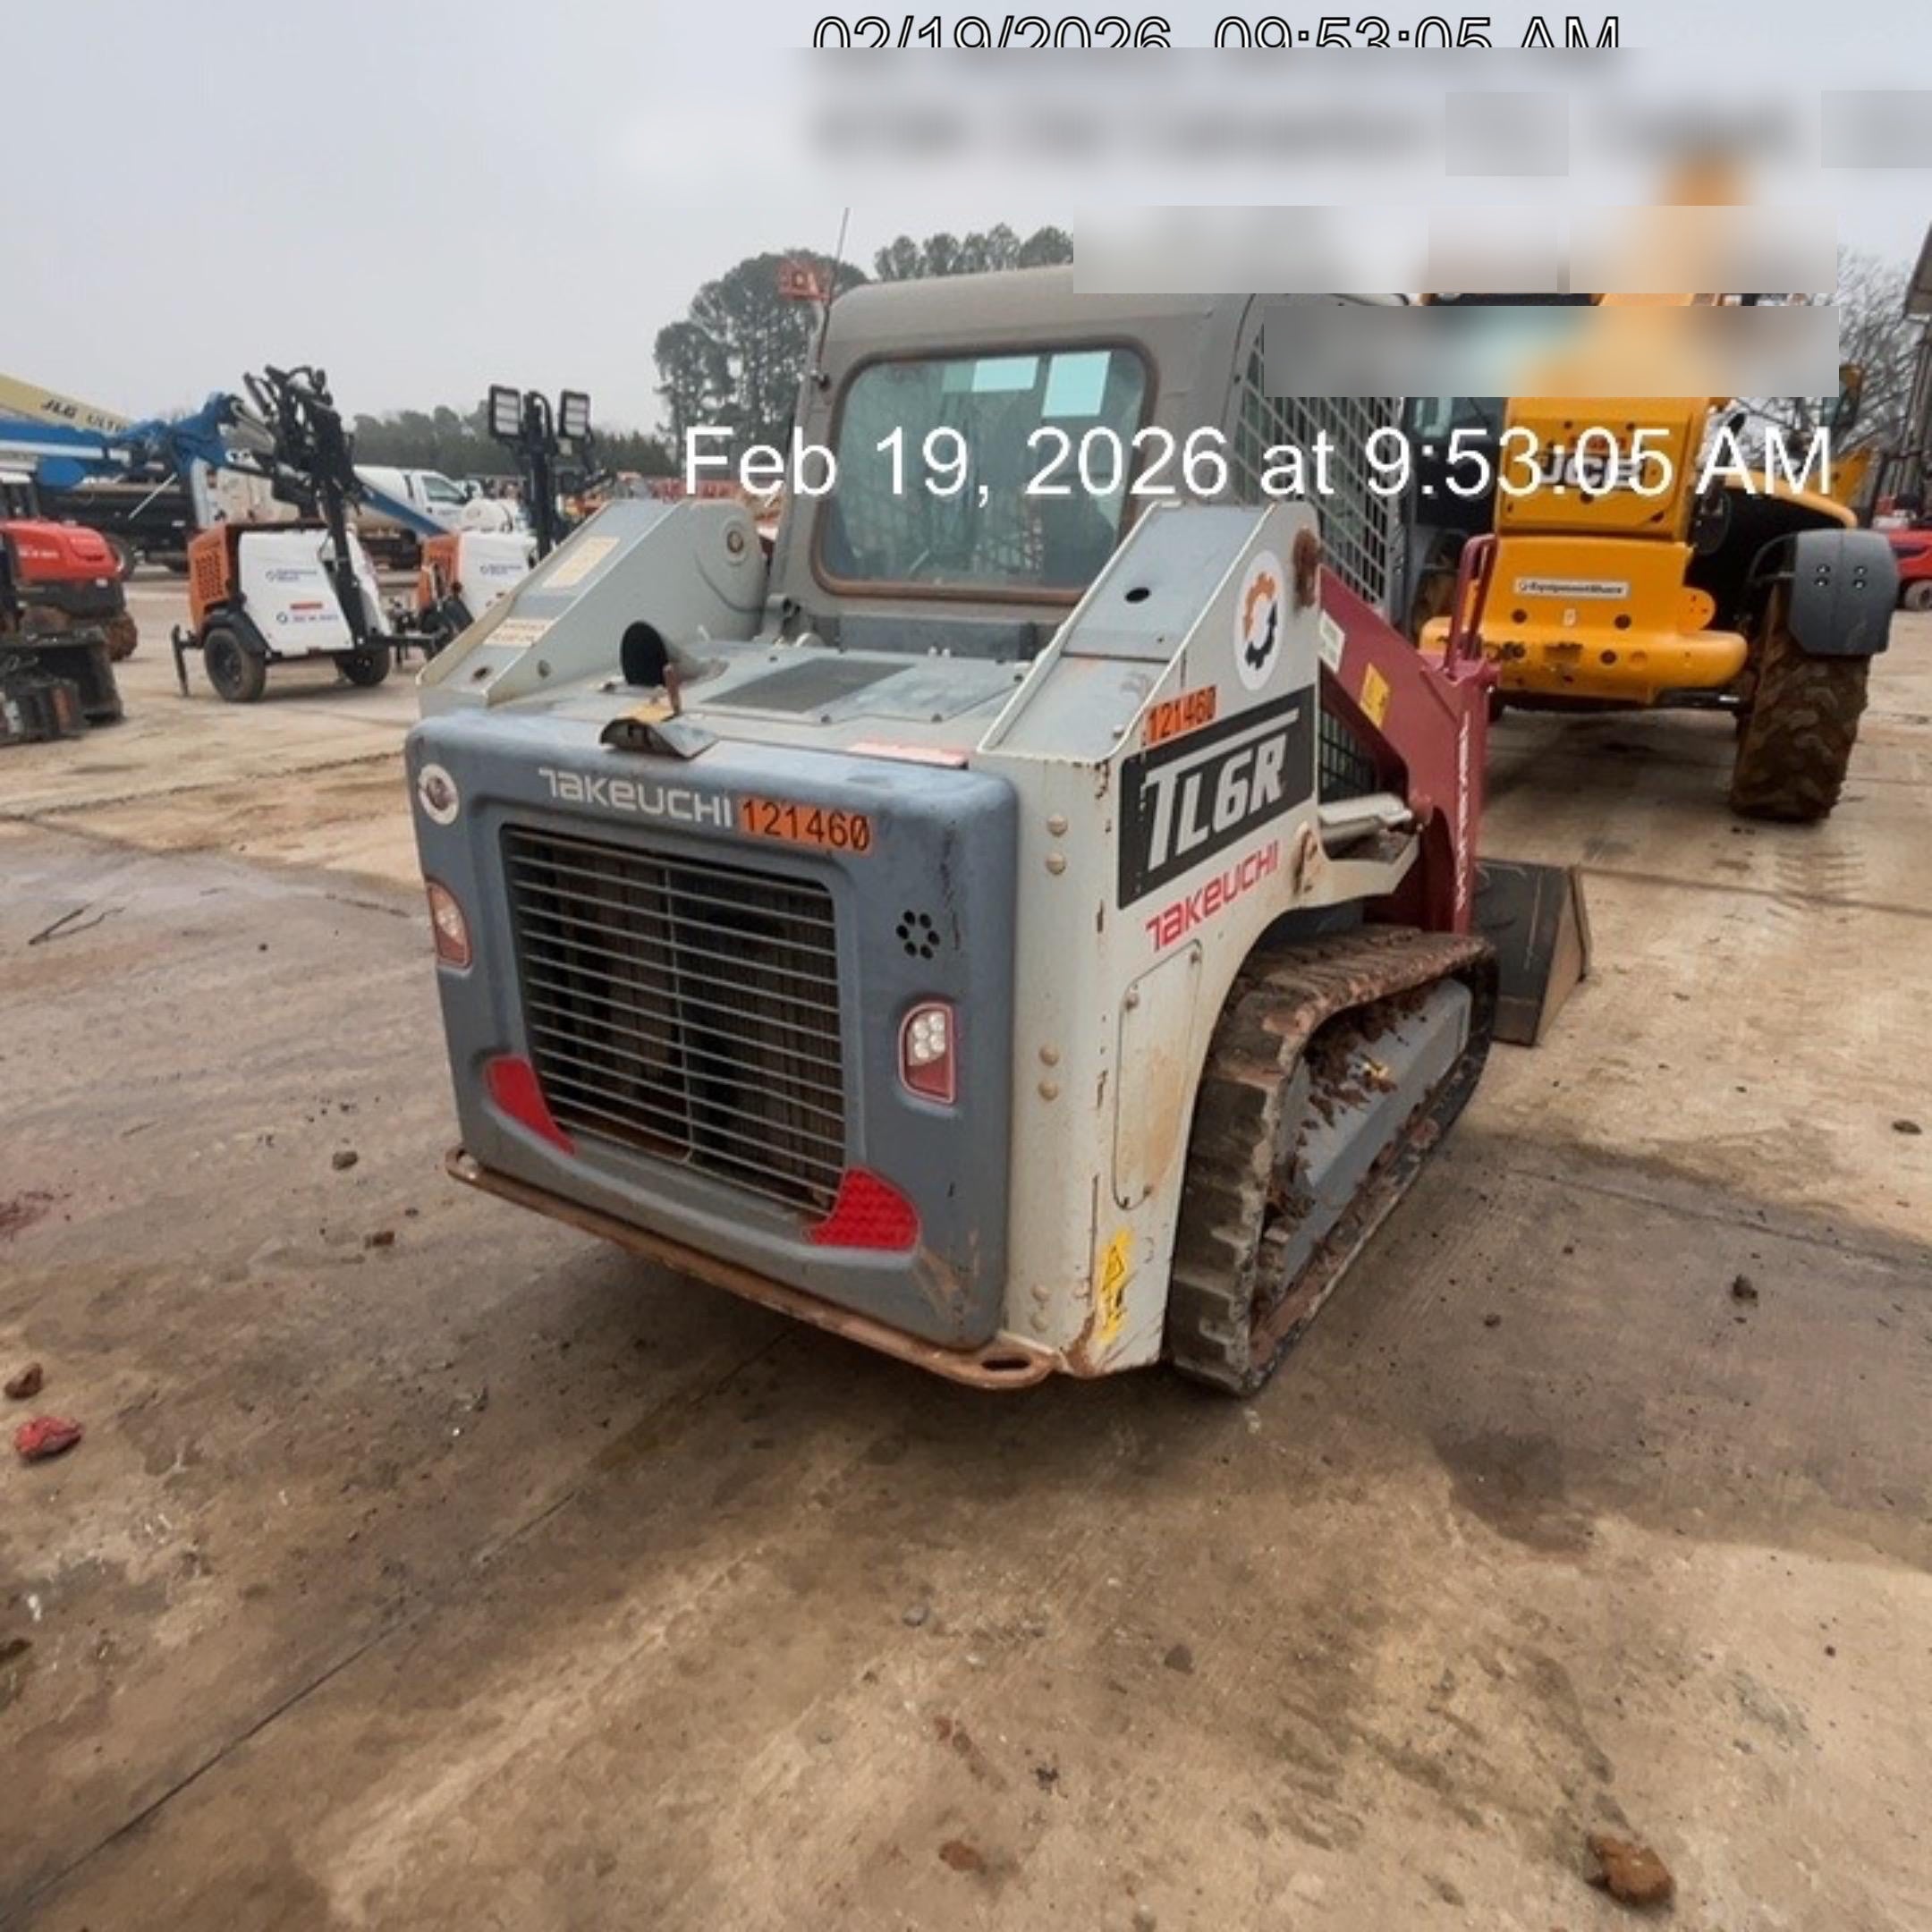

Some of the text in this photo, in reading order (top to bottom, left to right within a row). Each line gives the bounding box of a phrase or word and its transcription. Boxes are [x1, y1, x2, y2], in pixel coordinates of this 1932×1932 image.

[42, 399, 78, 419] JLG
[1141, 708, 1300, 873] TL6R
[741, 799, 871, 852] 121460
